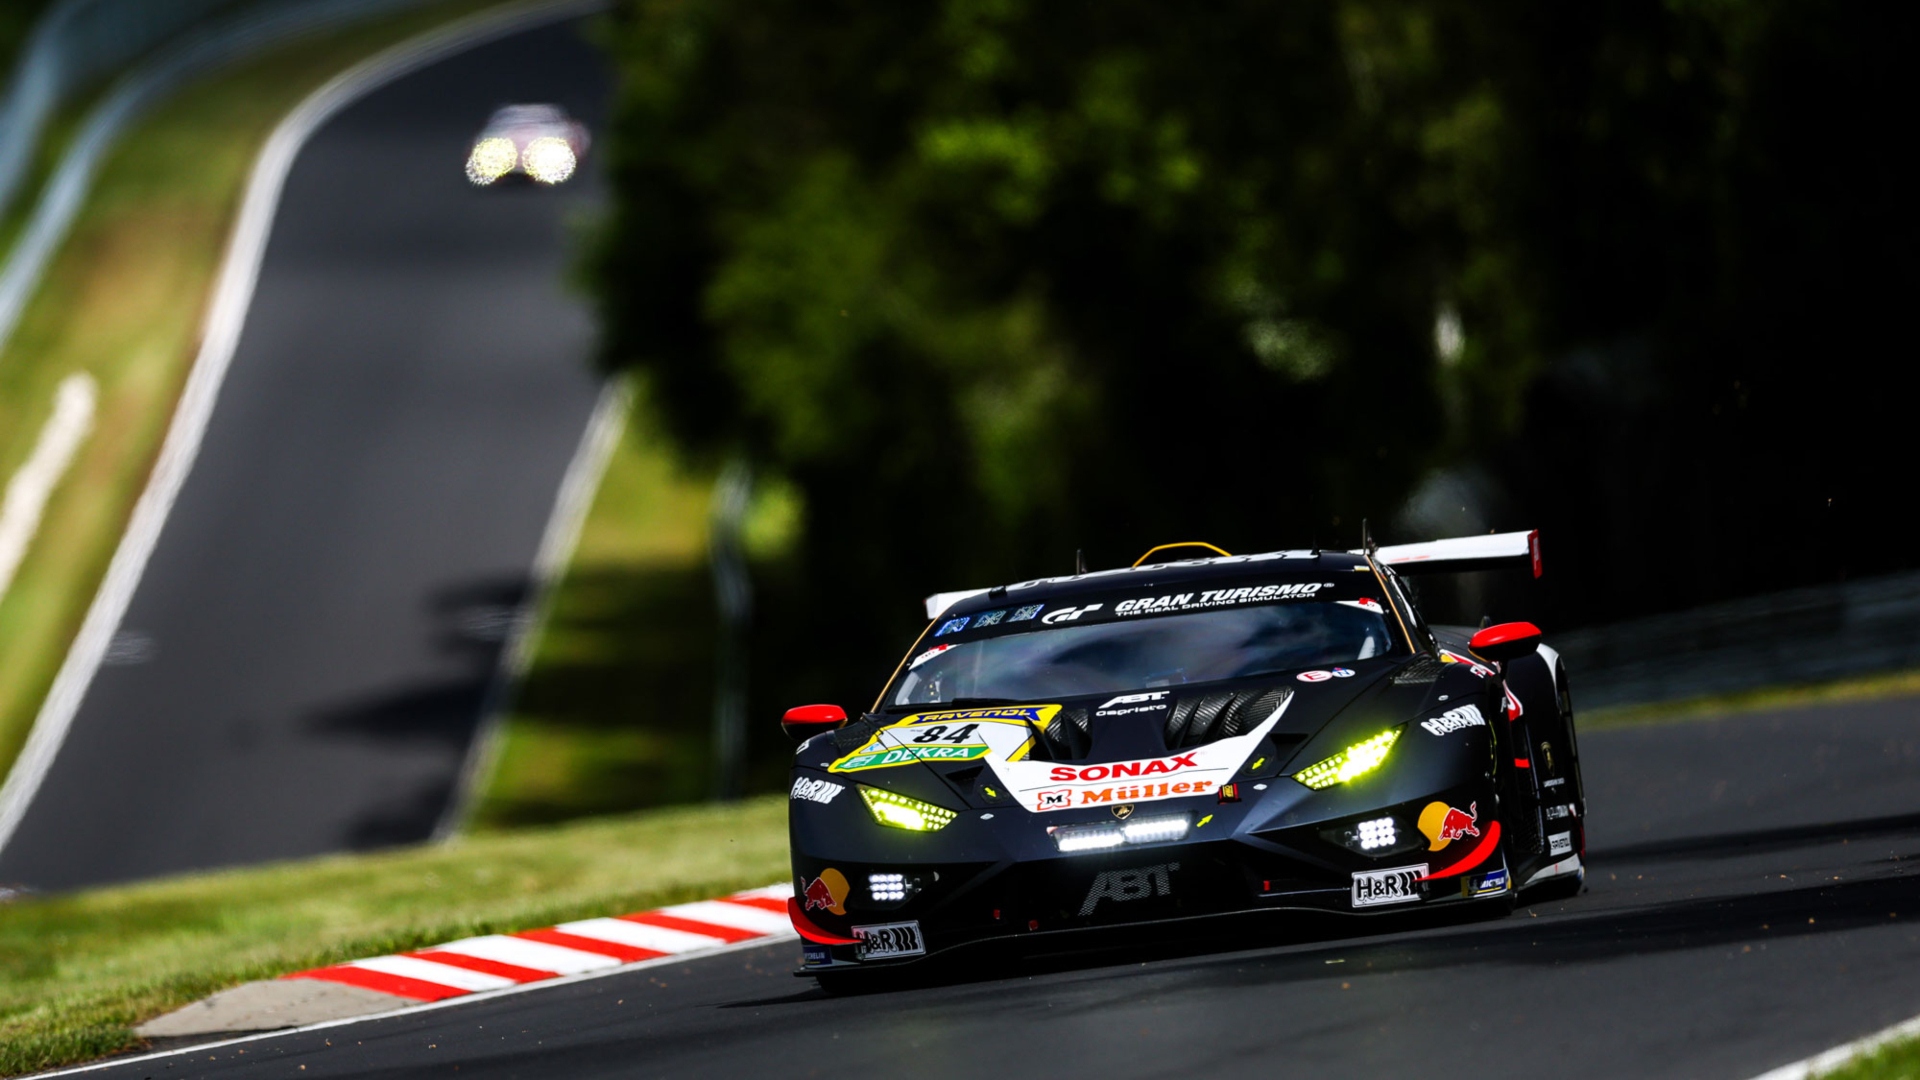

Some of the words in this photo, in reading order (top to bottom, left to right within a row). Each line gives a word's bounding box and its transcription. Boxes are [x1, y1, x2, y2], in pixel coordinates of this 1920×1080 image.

[1041, 603, 1104, 625] GT
[1115, 592, 1195, 612] GRAN
[1115, 608, 1142, 617] THE
[1144, 604, 1175, 614] REAL
[1181, 598, 1236, 610] DRIVING
[1239, 592, 1316, 604] SIMULATOR
[922, 708, 1032, 722] RAVENOL
[913, 724, 981, 744] 84
[880, 747, 970, 764] DEKRA
[1049, 751, 1198, 782] SONAX
[1080, 780, 1213, 805] Müller
[1078, 862, 1181, 917] ABT
